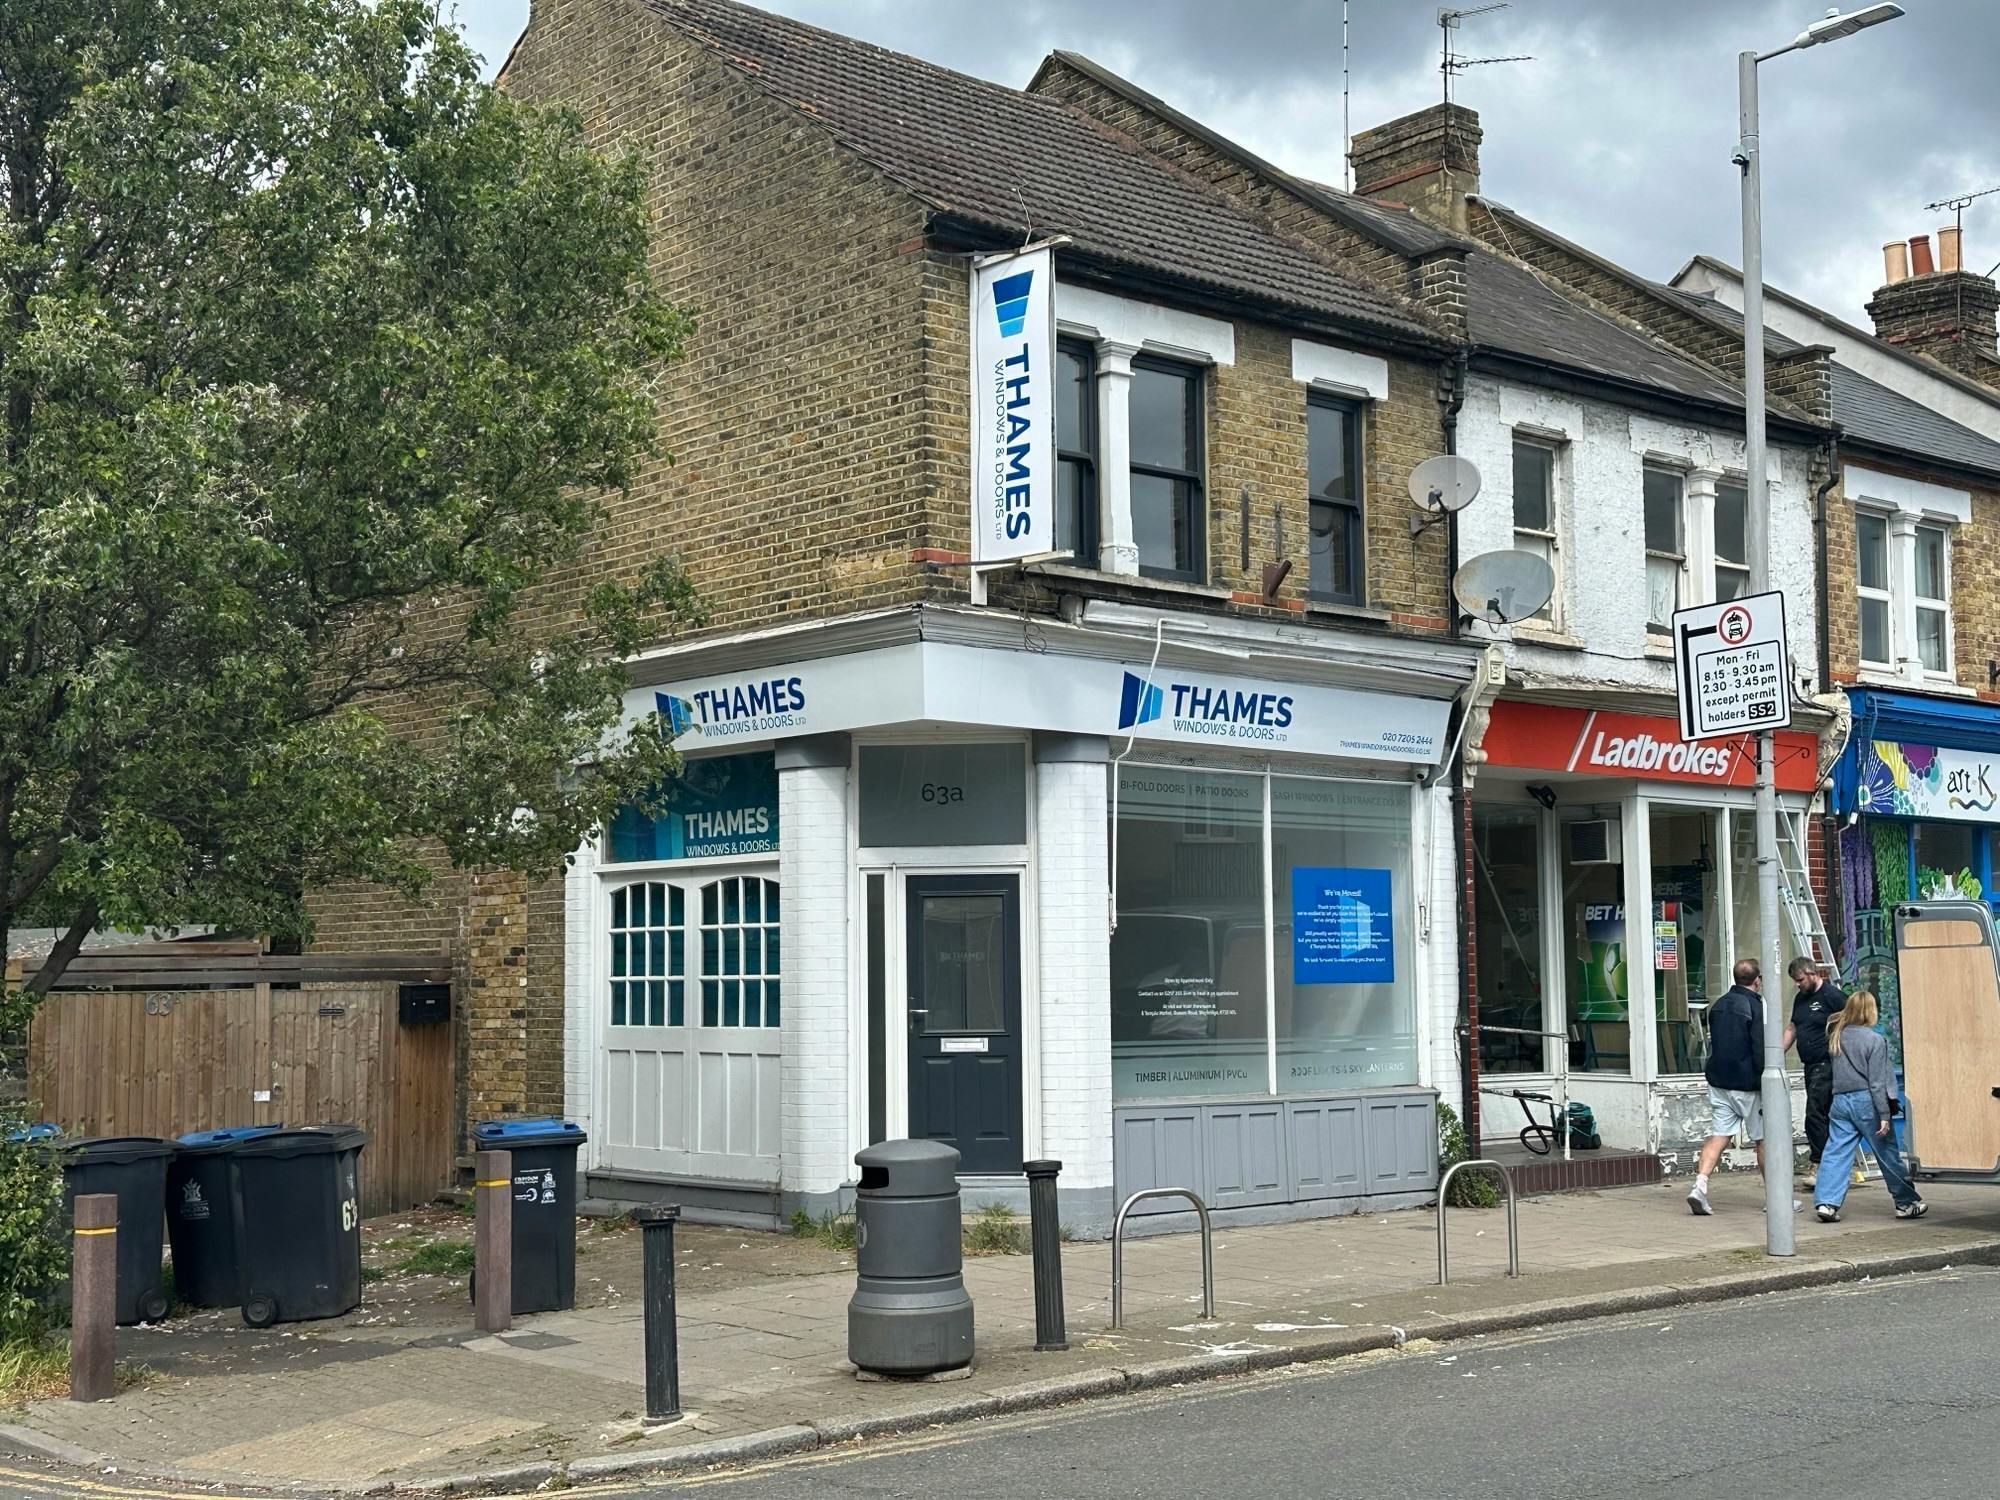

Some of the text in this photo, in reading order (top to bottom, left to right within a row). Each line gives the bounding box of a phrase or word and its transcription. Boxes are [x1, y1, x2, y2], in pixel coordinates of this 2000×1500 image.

[994, 359, 1004, 443] WINDOWS
[1005, 343, 1031, 540] THAMES
[995, 448, 1004, 457] &
[994, 463, 1004, 519] DOORS
[1716, 656, 1738, 666] Mon
[1746, 650, 1760, 661] Fri
[1704, 670, 1725, 681] 8.15
[1732, 664, 1757, 677] 9.30
[1759, 663, 1774, 672] am
[1703, 681, 1727, 694] 2.30
[1734, 676, 1759, 688] 3.45
[1761, 675, 1777, 686] pm
[694, 677, 805, 723] THAMES
[1171, 684, 1293, 728] THAMES
[1706, 687, 1776, 707] except permit
[1708, 703, 1775, 722] holders SS2
[703, 714, 806, 737] WINDOWS & DOORS LTD
[1173, 719, 1227, 736] WINDOWS
[1229, 725, 1236, 737] &
[1239, 725, 1275, 740] DOORS
[1382, 732, 1397, 742] 020
[1590, 732, 1731, 776] Ladbrokes
[921, 783, 964, 805] 63a
[1120, 780, 1155, 792] BI-FOLD
[1156, 782, 1185, 794] DOORS
[1195, 785, 1219, 795] PATIO
[1221, 787, 1249, 798] DOORS
[685, 806, 769, 839] THAMES
[686, 842, 729, 857] WINDOWS
[731, 842, 738, 853] &
[739, 839, 770, 853] DOORS
[1585, 905, 1613, 920] BET
[1135, 1072, 1166, 1082] TIMBER
[1173, 1070, 1220, 1080] ALUMINIUM
